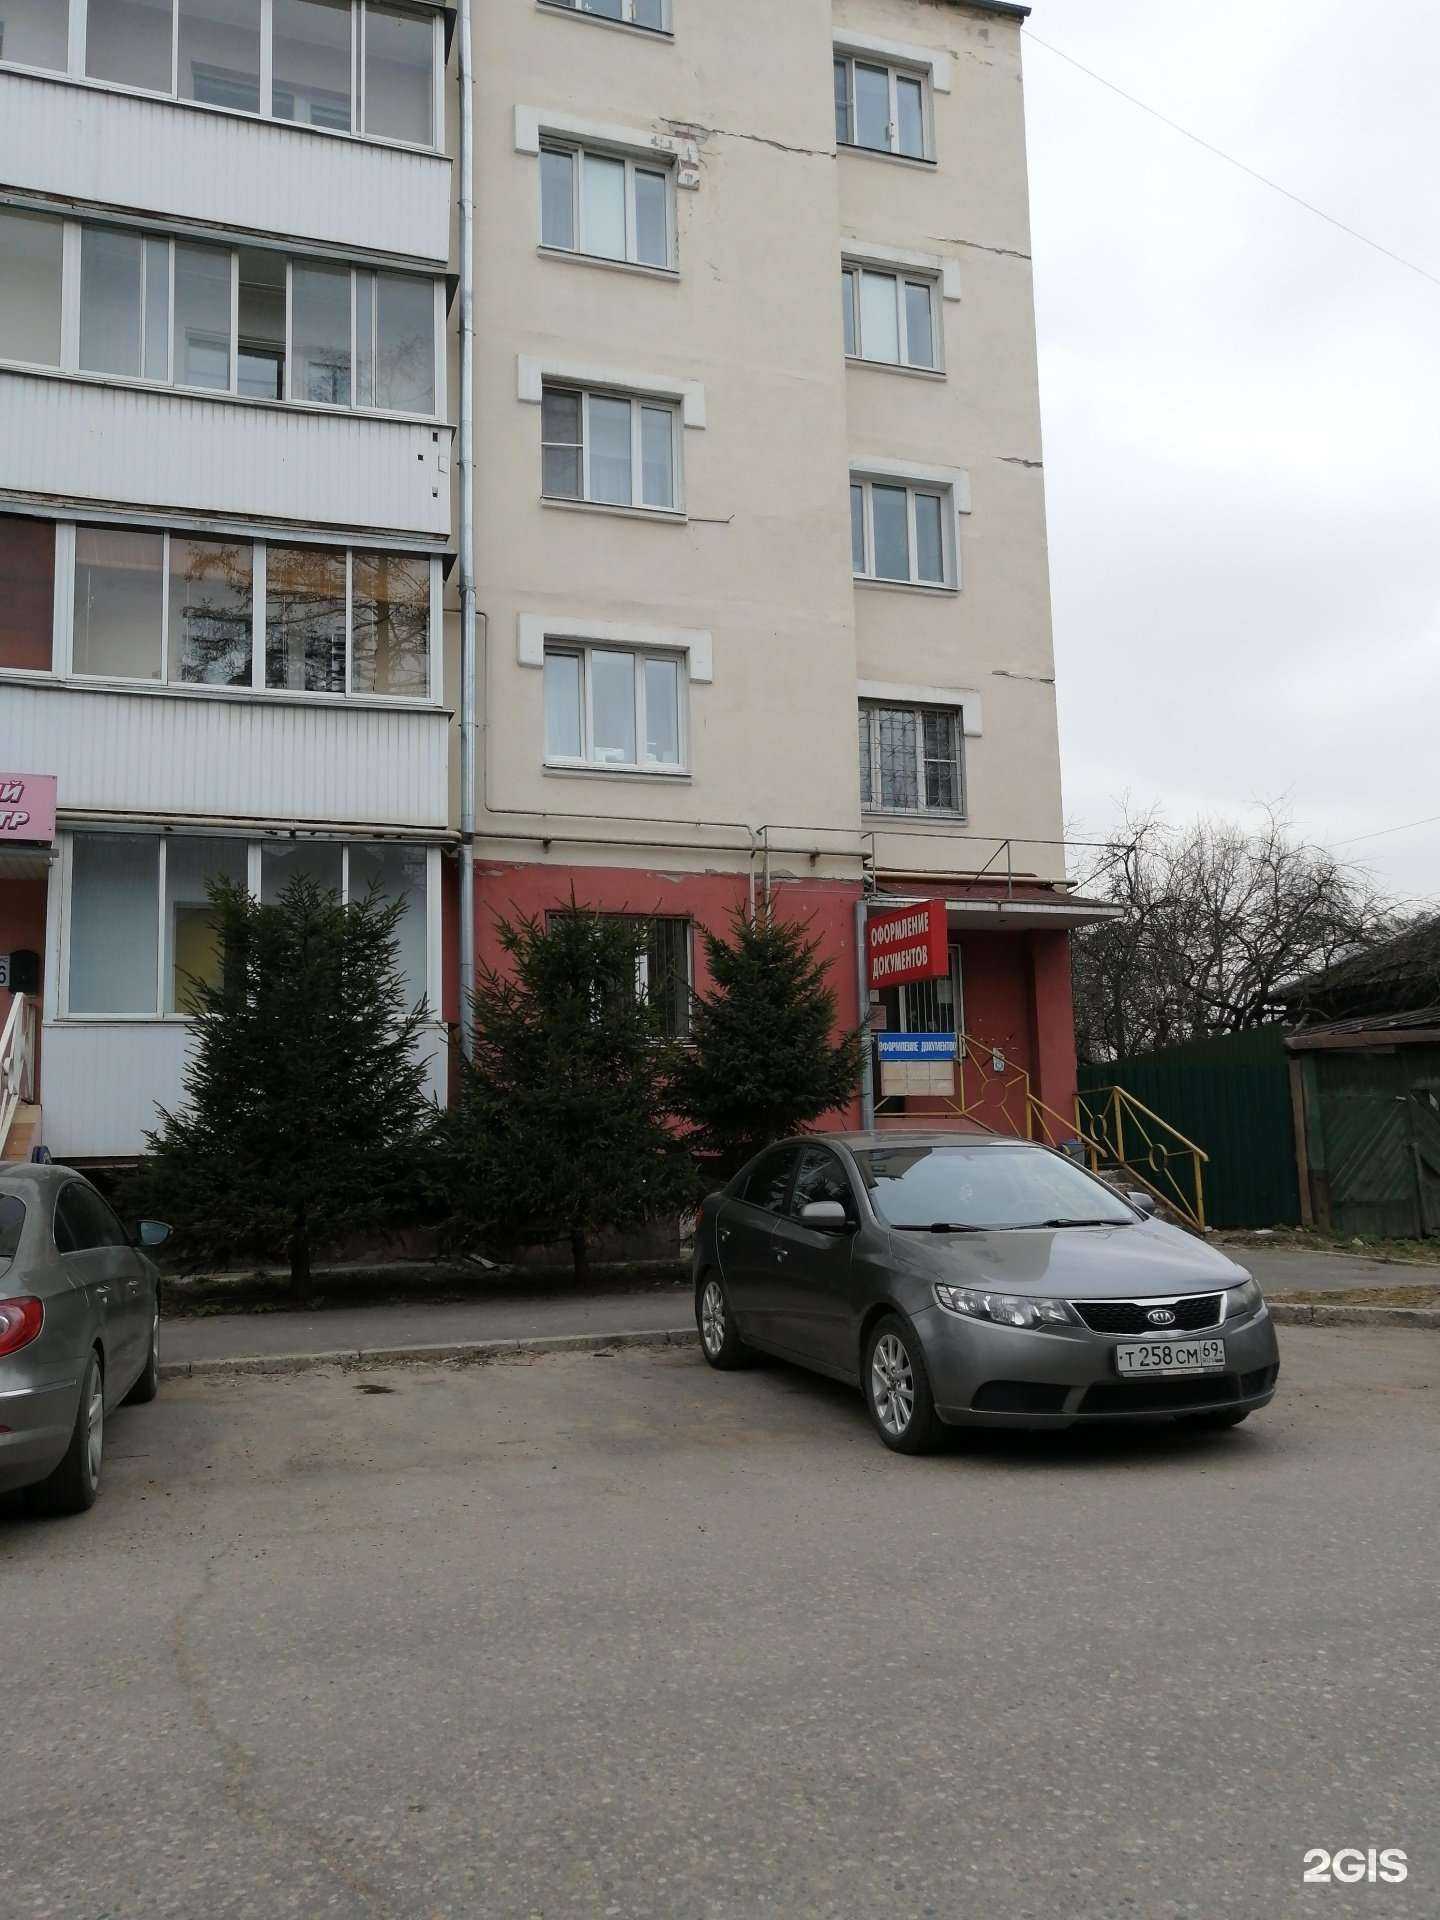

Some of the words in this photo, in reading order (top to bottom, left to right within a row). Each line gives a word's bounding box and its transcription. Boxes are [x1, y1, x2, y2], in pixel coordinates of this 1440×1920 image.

[871, 912, 929, 947] ОФОРМЛЕНИЕ
[872, 945, 928, 980] ДОКУМЕНТОВ
[1152, 1312, 1171, 1322] KIA
